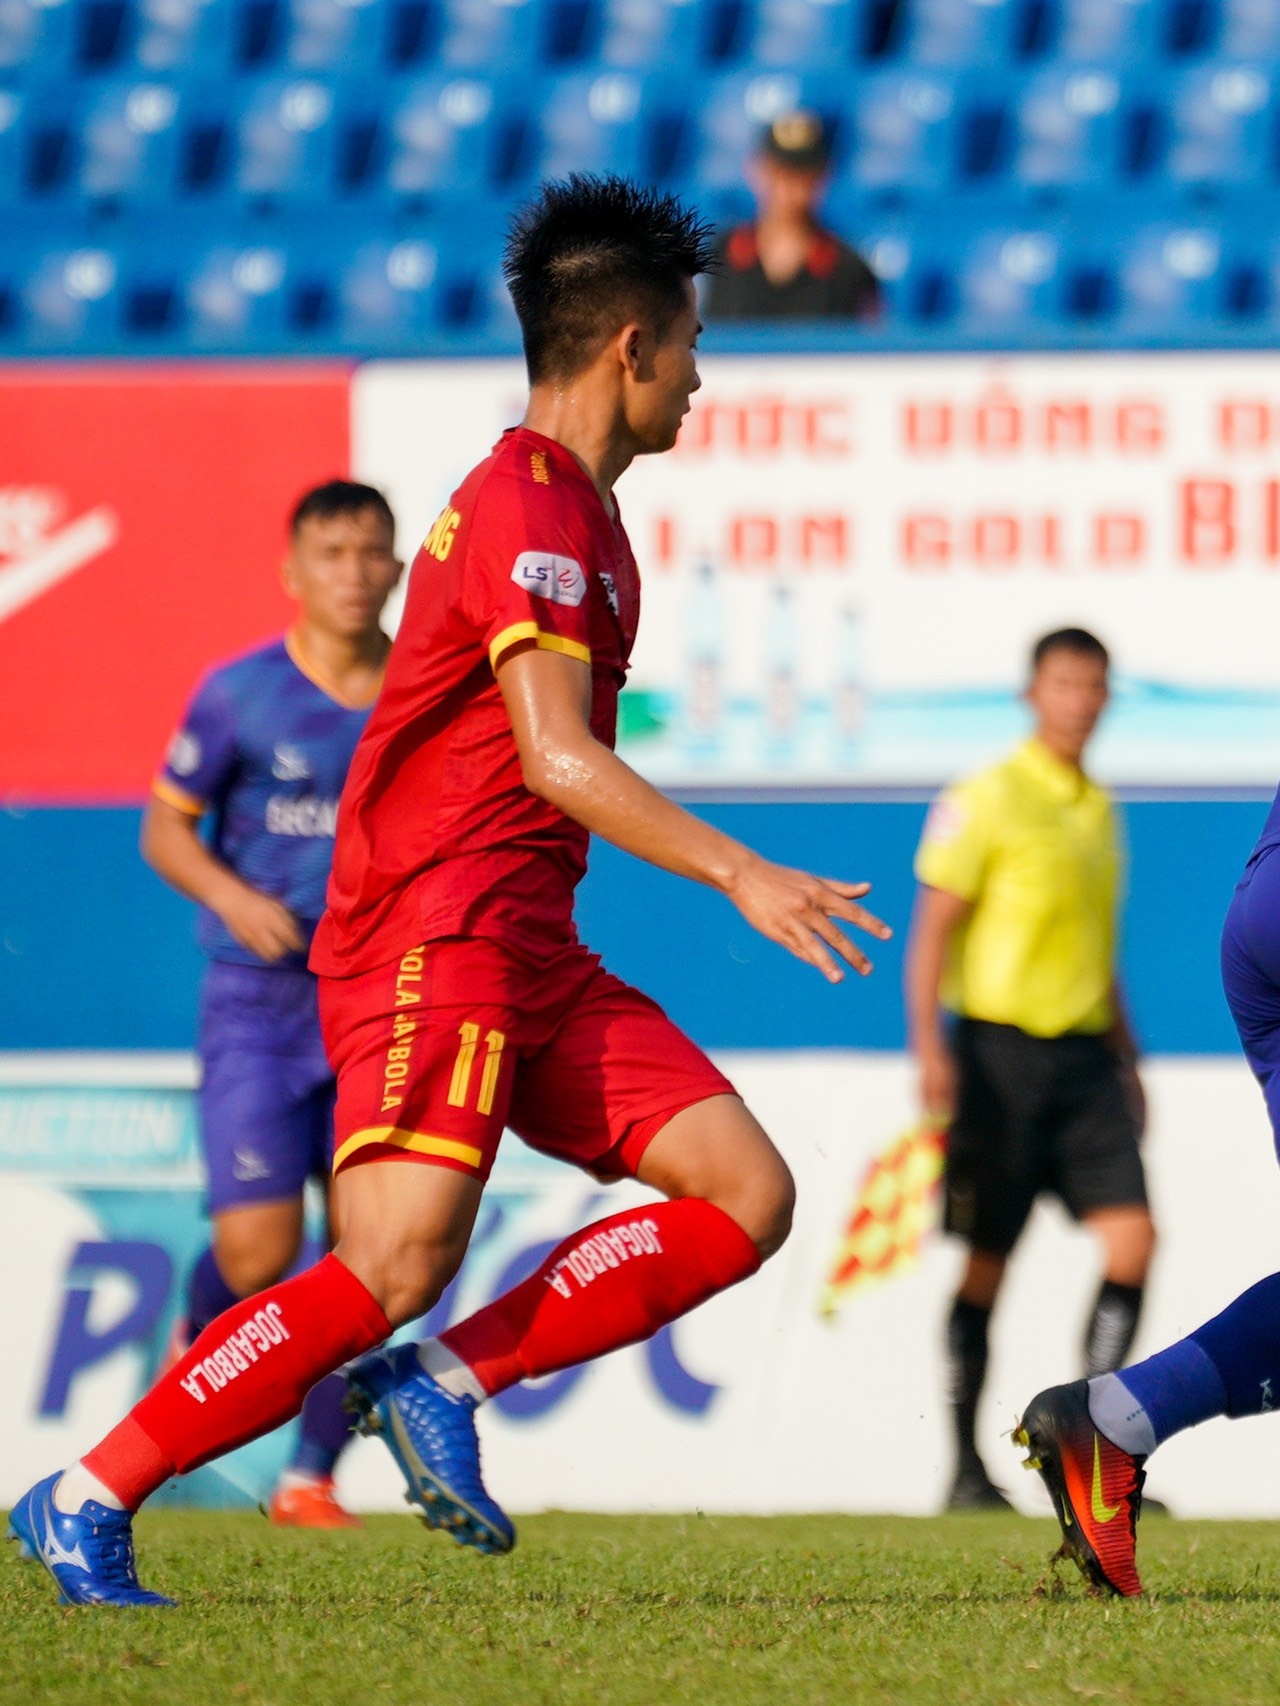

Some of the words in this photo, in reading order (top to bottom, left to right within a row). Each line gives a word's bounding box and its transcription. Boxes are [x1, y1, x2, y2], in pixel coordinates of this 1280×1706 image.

[522, 566, 549, 582] LS
[902, 512, 1149, 567] GOLD
[447, 1021, 505, 1116] 11
[543, 1218, 663, 1299] JOGARBOLA
[179, 1301, 291, 1404] JOGARBOLA
